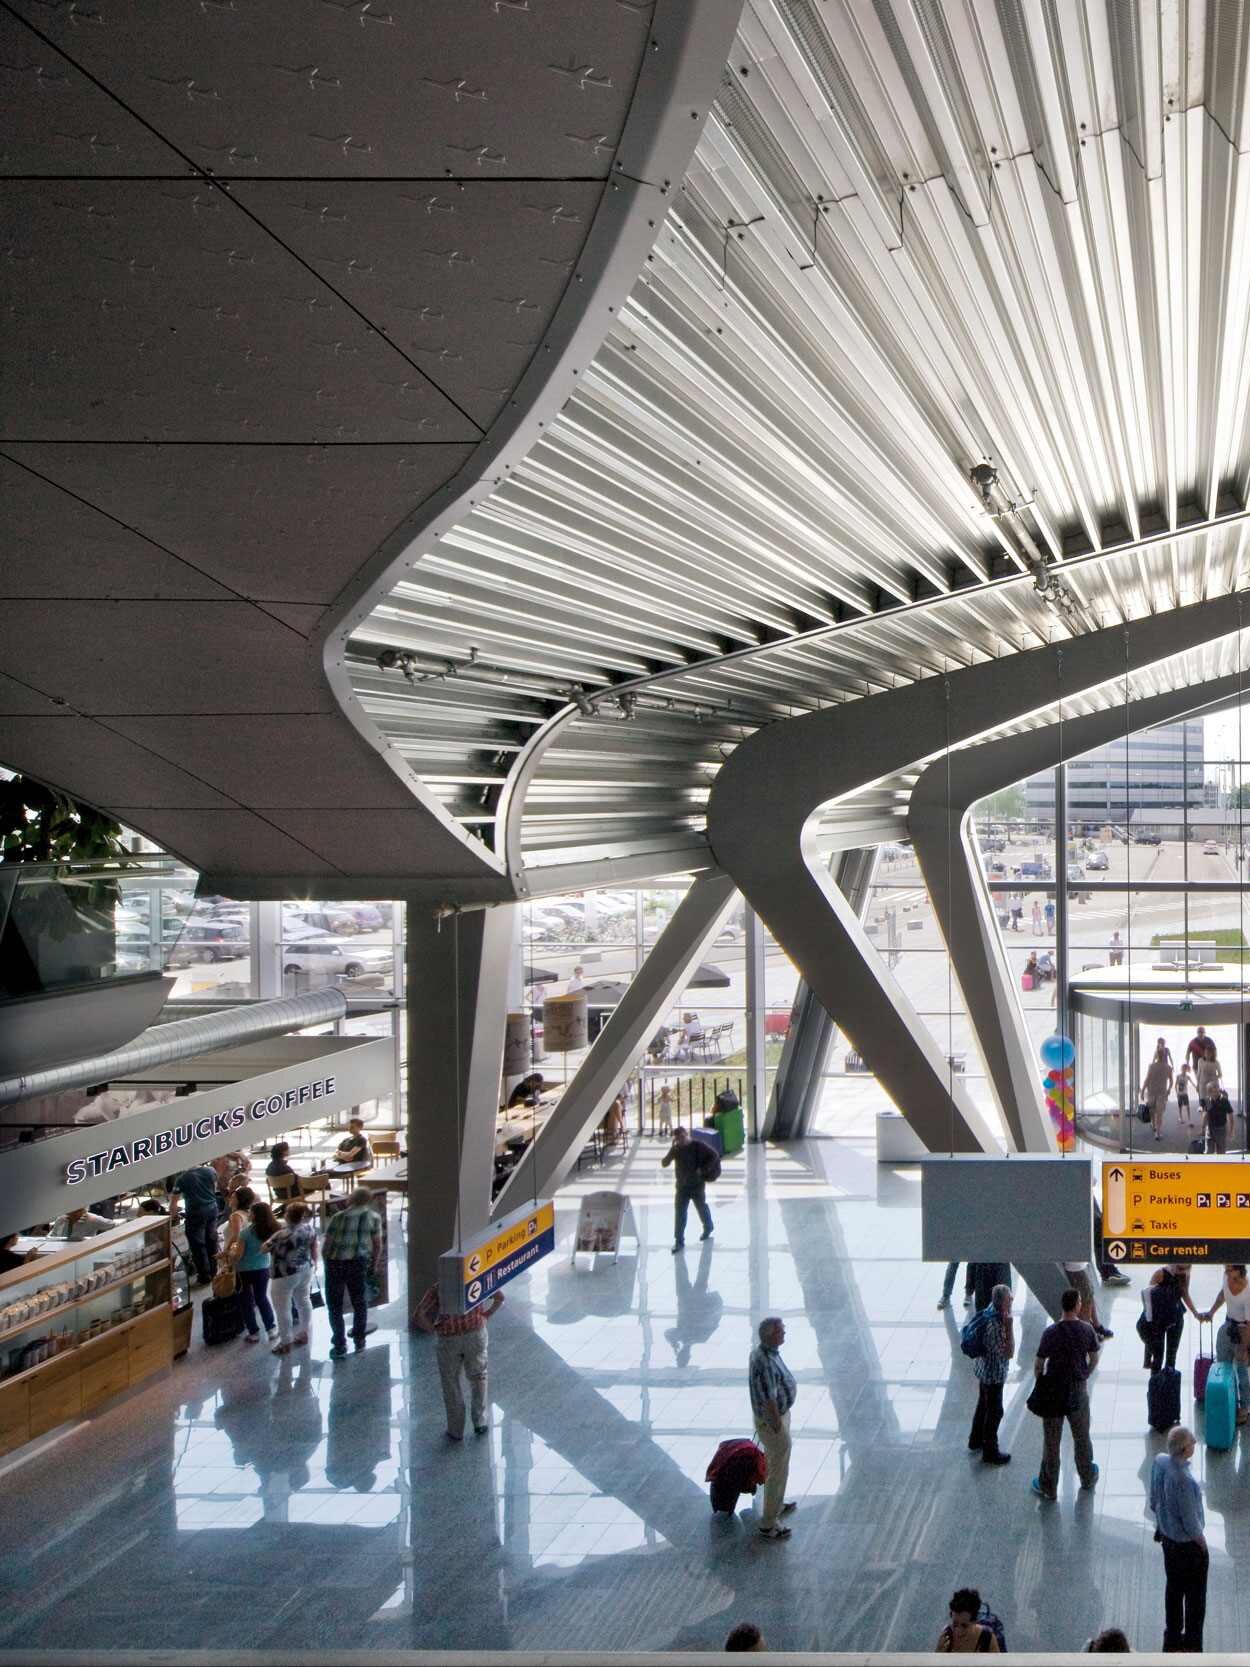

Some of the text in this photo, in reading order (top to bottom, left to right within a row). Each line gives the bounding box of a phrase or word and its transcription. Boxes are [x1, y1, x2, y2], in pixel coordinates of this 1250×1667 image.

[67, 1077, 336, 1185] STARBUCKS COFFEE
[1149, 1170, 1181, 1180] Buses
[1150, 1195, 1192, 1206] Parking
[1150, 1220, 1177, 1230] Taxis
[497, 1230, 526, 1251] Parking
[1150, 1245, 1208, 1255] Car rental
[497, 1244, 540, 1279] Restaurant
